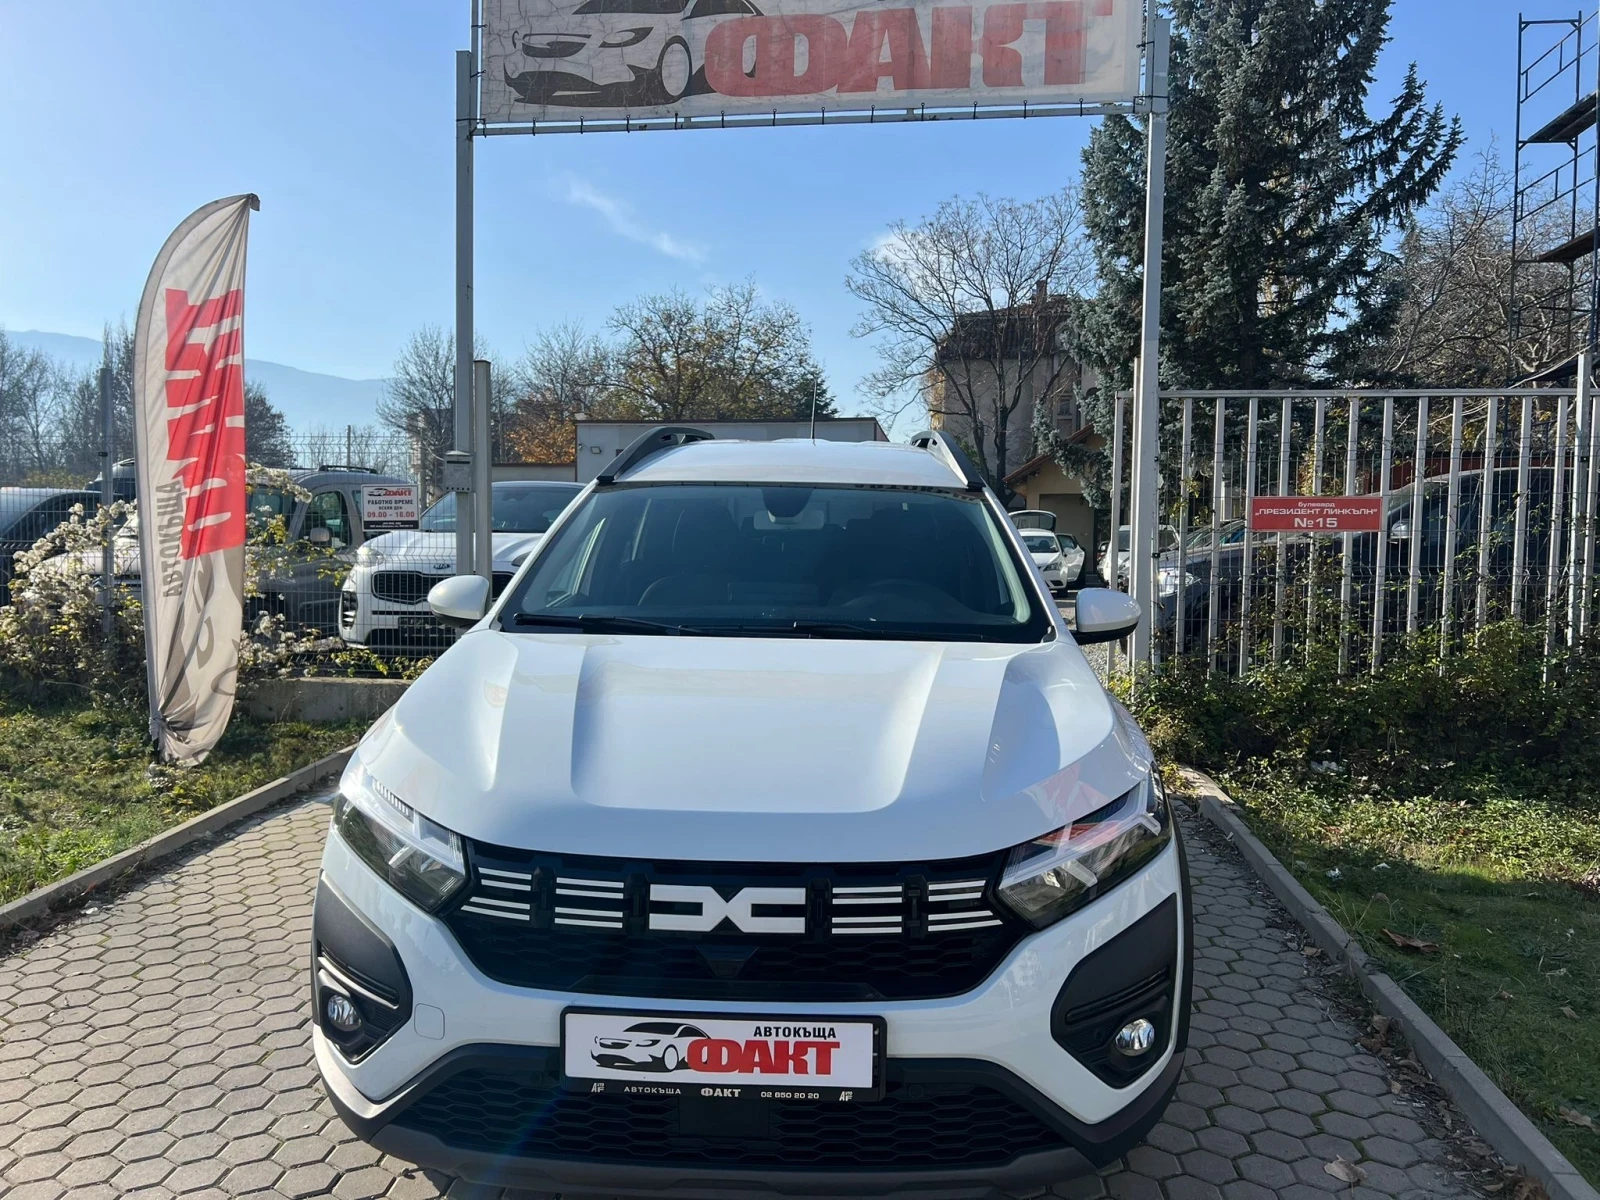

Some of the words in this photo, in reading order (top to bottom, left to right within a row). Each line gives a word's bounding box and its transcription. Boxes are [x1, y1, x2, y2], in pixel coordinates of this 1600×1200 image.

[704, 0, 1113, 97] ФАКТ
[155, 480, 187, 598] АВТОКЪЩА
[753, 1026, 837, 1040] АВТОКЪЩА
[686, 1038, 840, 1076] ФАКТ
[700, 1087, 741, 1098] ФАКТ
[775, 1091, 791, 1099] 850
[808, 1092, 819, 1100] 20
